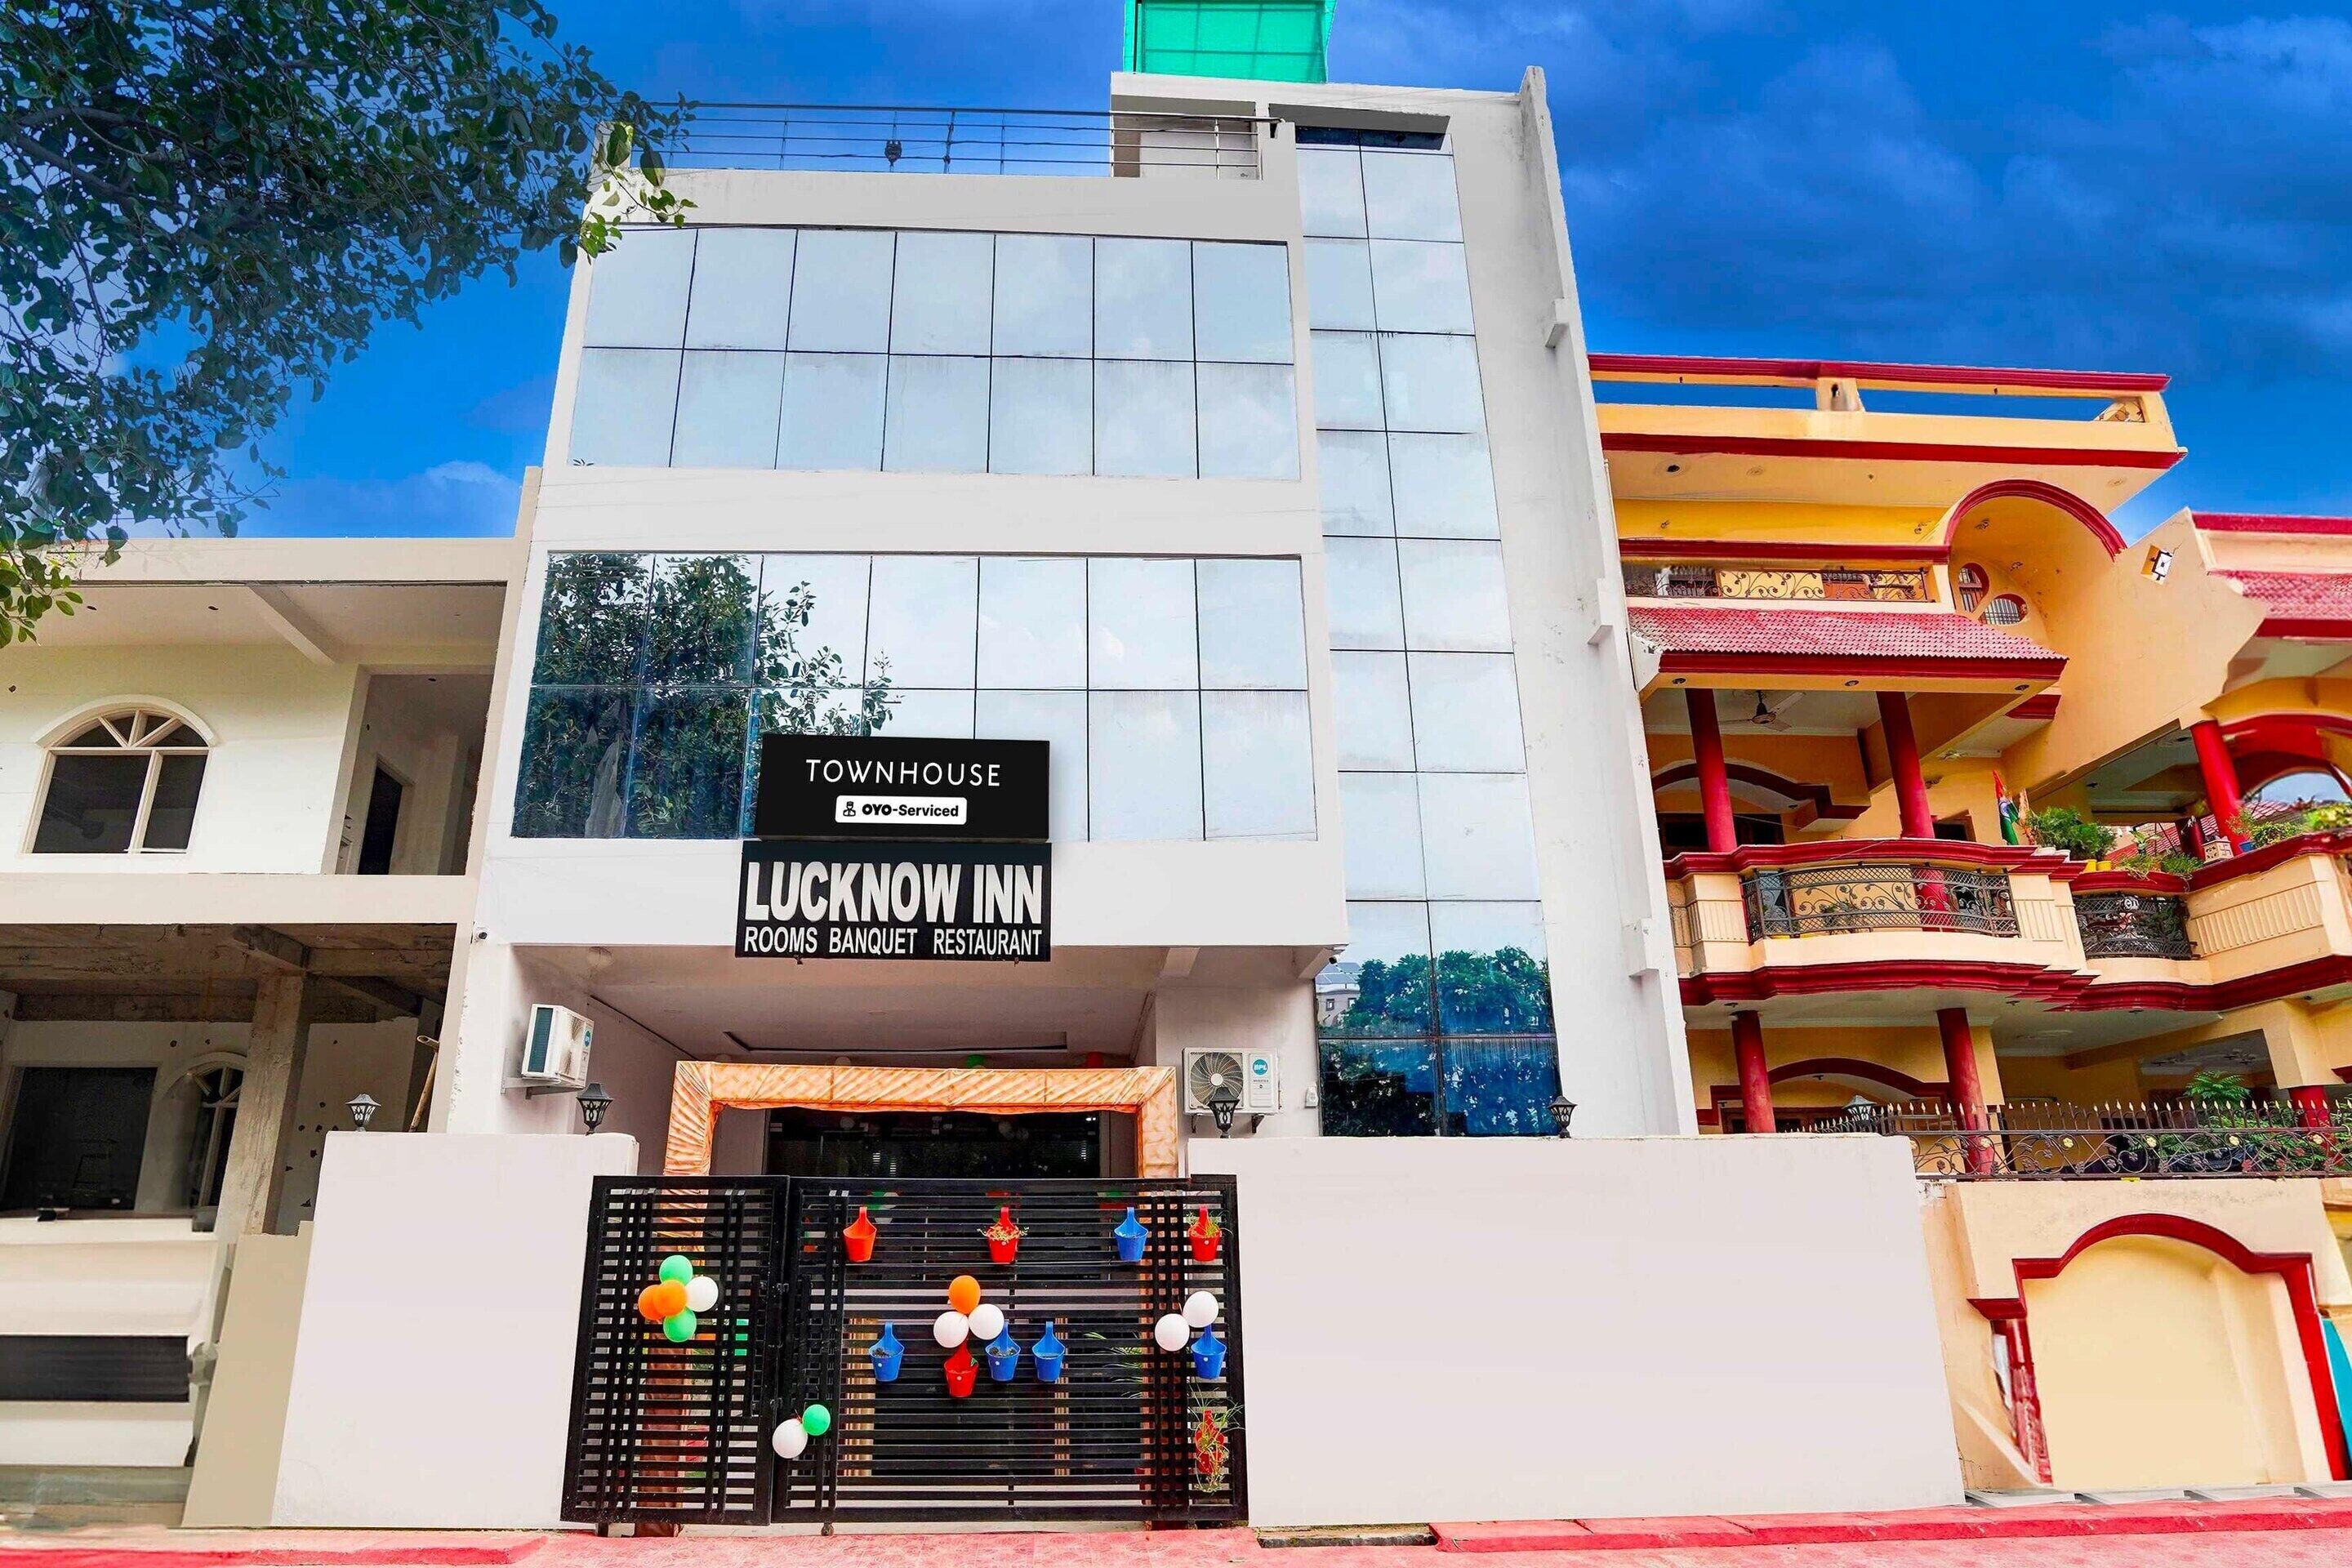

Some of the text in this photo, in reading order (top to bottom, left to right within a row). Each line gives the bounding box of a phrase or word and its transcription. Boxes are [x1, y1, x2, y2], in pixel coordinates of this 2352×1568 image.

[805, 759, 1000, 786] TOWNHOUSE
[862, 804, 959, 817] OYO-Serviced
[744, 862, 1043, 924] LUCKNOW INN
[744, 926, 1043, 956] ROOMS BANQUET RESTAURANT
